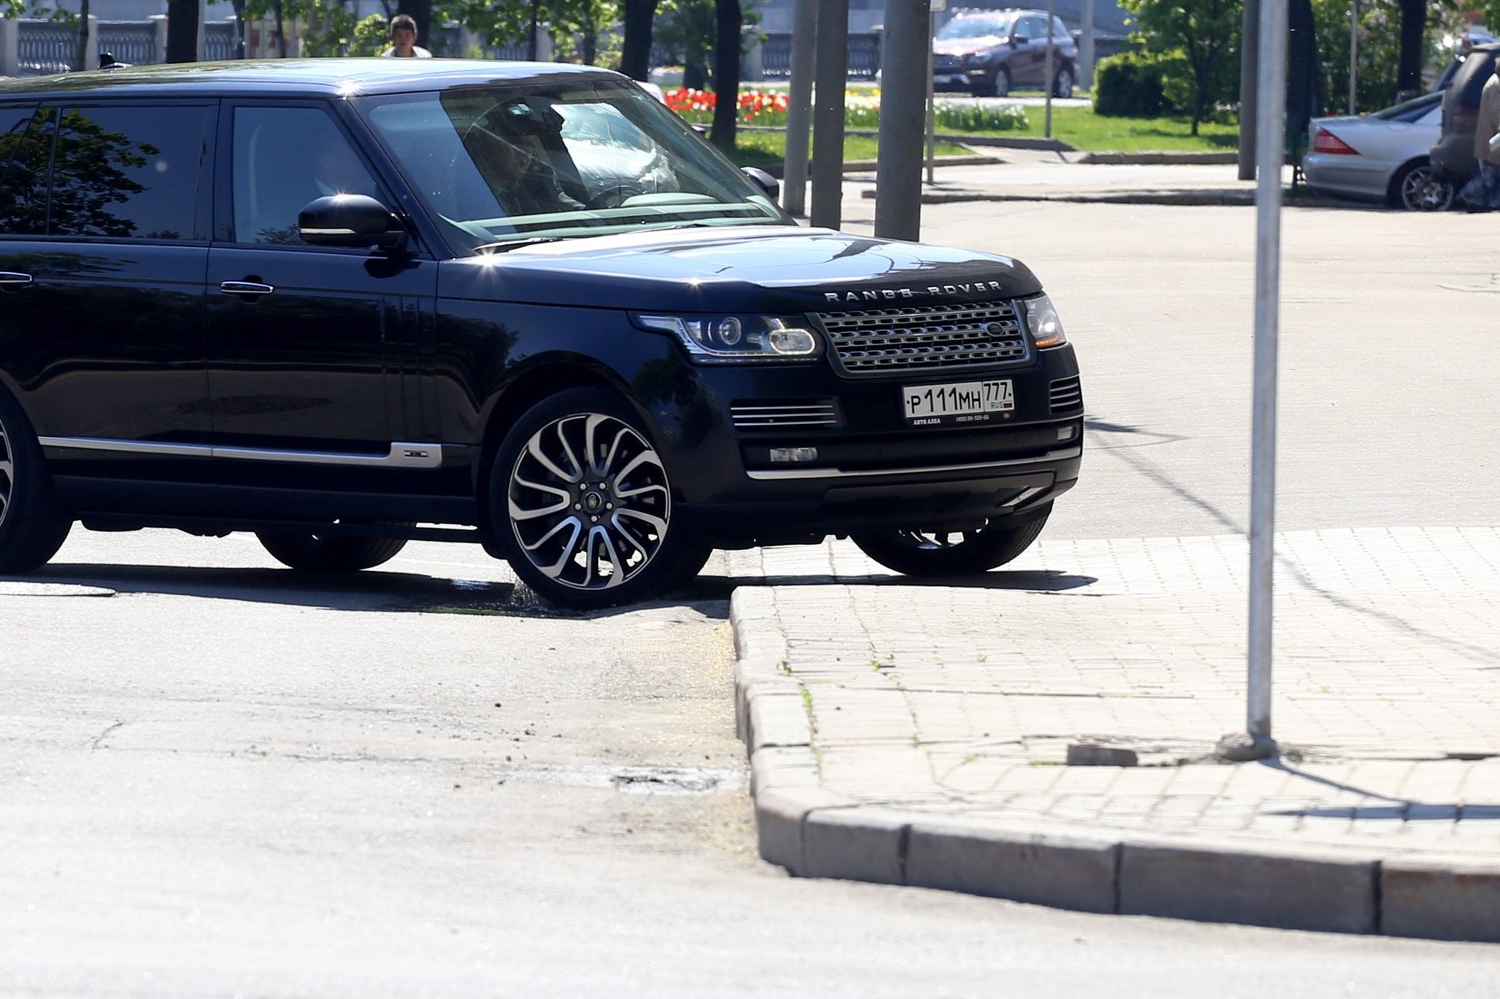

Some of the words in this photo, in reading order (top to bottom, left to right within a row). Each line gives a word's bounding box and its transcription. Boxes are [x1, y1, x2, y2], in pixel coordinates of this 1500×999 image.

[824, 288, 914, 302] RANGE
[927, 281, 1002, 295] ROVER
[990, 401, 1003, 409] RUS
